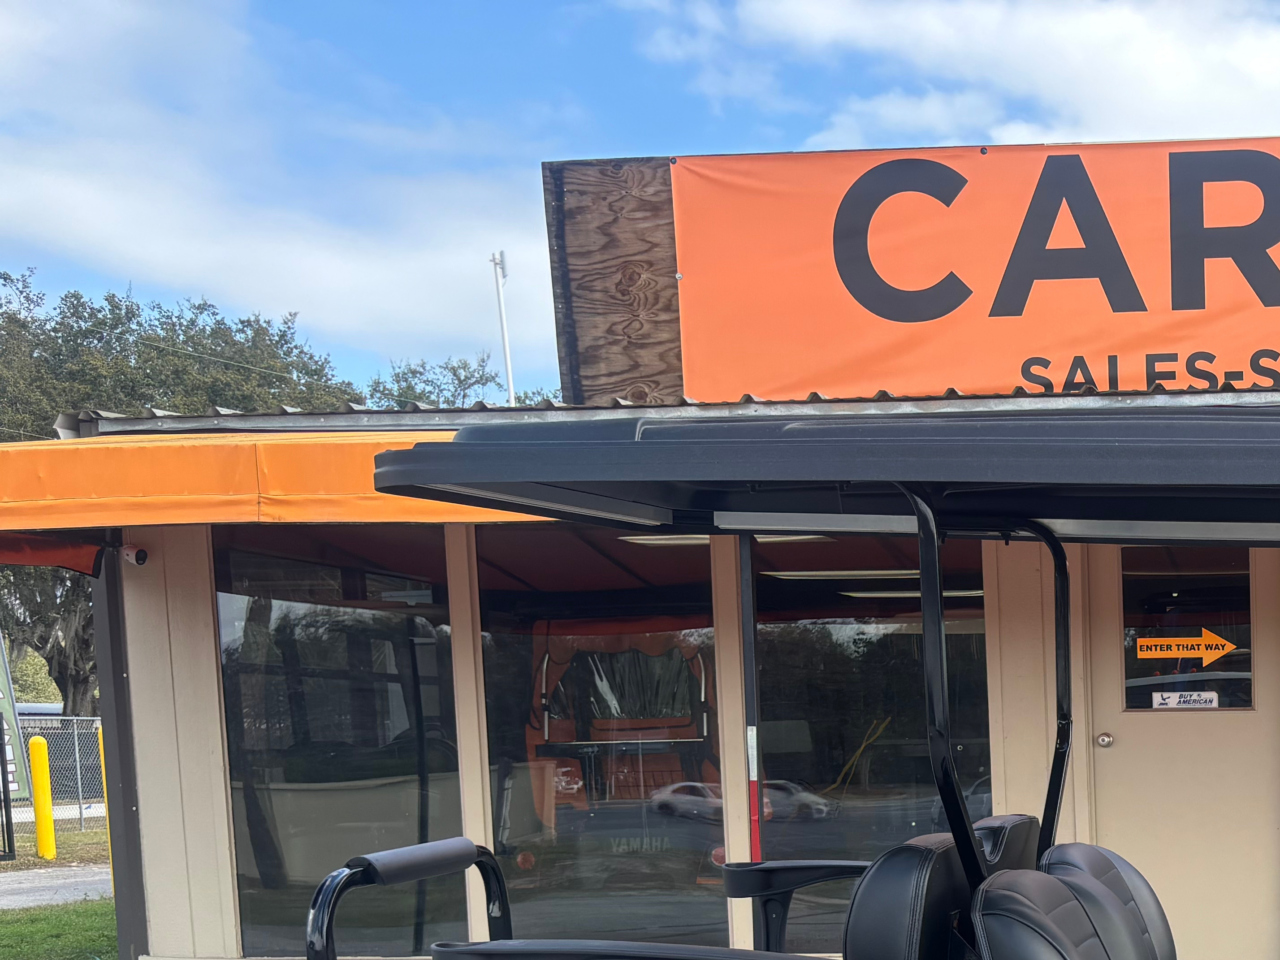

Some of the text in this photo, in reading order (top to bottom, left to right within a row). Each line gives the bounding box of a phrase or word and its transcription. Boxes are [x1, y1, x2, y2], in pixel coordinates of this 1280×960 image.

[1139, 643, 1227, 652] ENTER THAT WAY
[610, 837, 671, 852] YAMAHA
